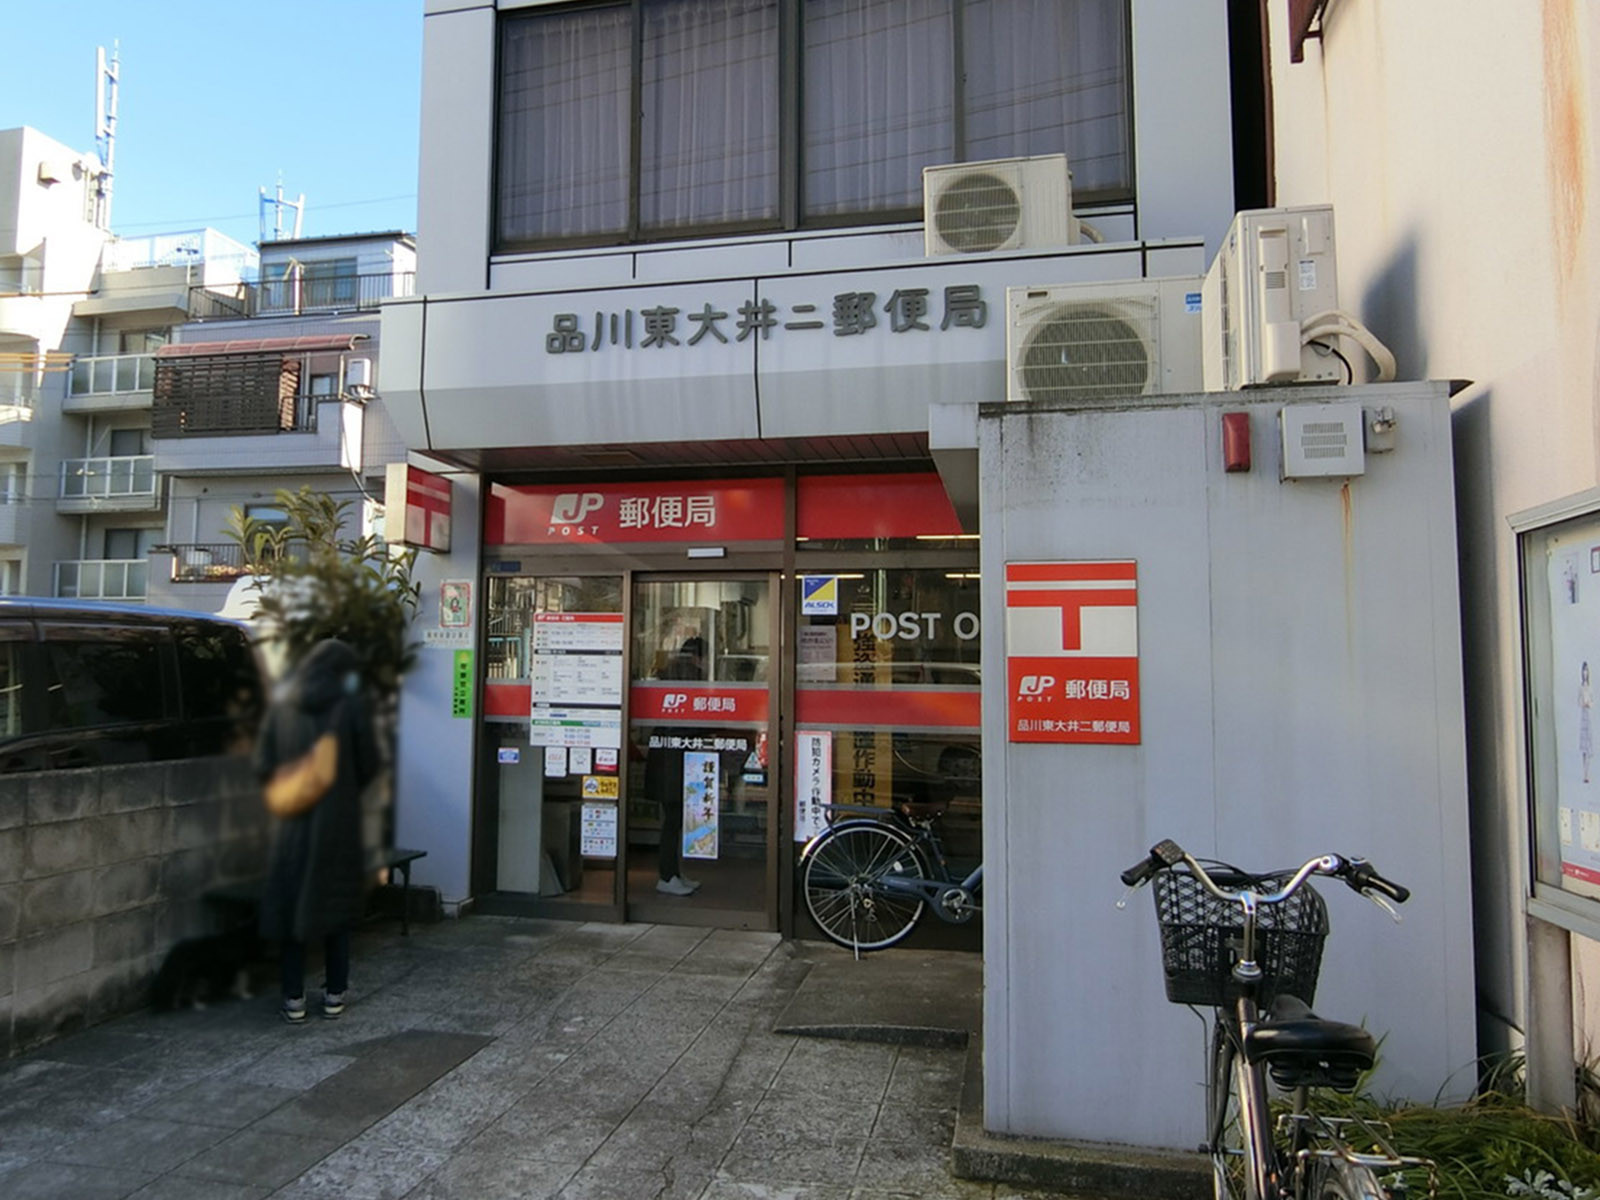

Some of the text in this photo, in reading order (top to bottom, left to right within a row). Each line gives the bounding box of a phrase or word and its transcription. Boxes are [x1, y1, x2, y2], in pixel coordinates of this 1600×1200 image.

[546, 285, 987, 353] 品川東大井二郵便局
[550, 493, 716, 528] JP 郵便局
[548, 526, 599, 535] POST
[851, 612, 941, 640] POST
[1019, 675, 1130, 700] JP 郵便局
[662, 693, 736, 712] JP 郵便局
[1017, 719, 1131, 734] 品川東大井二郵便局
[649, 736, 748, 752] 品川東大井二郵便局
[702, 761, 715, 823] 謹賀新年
